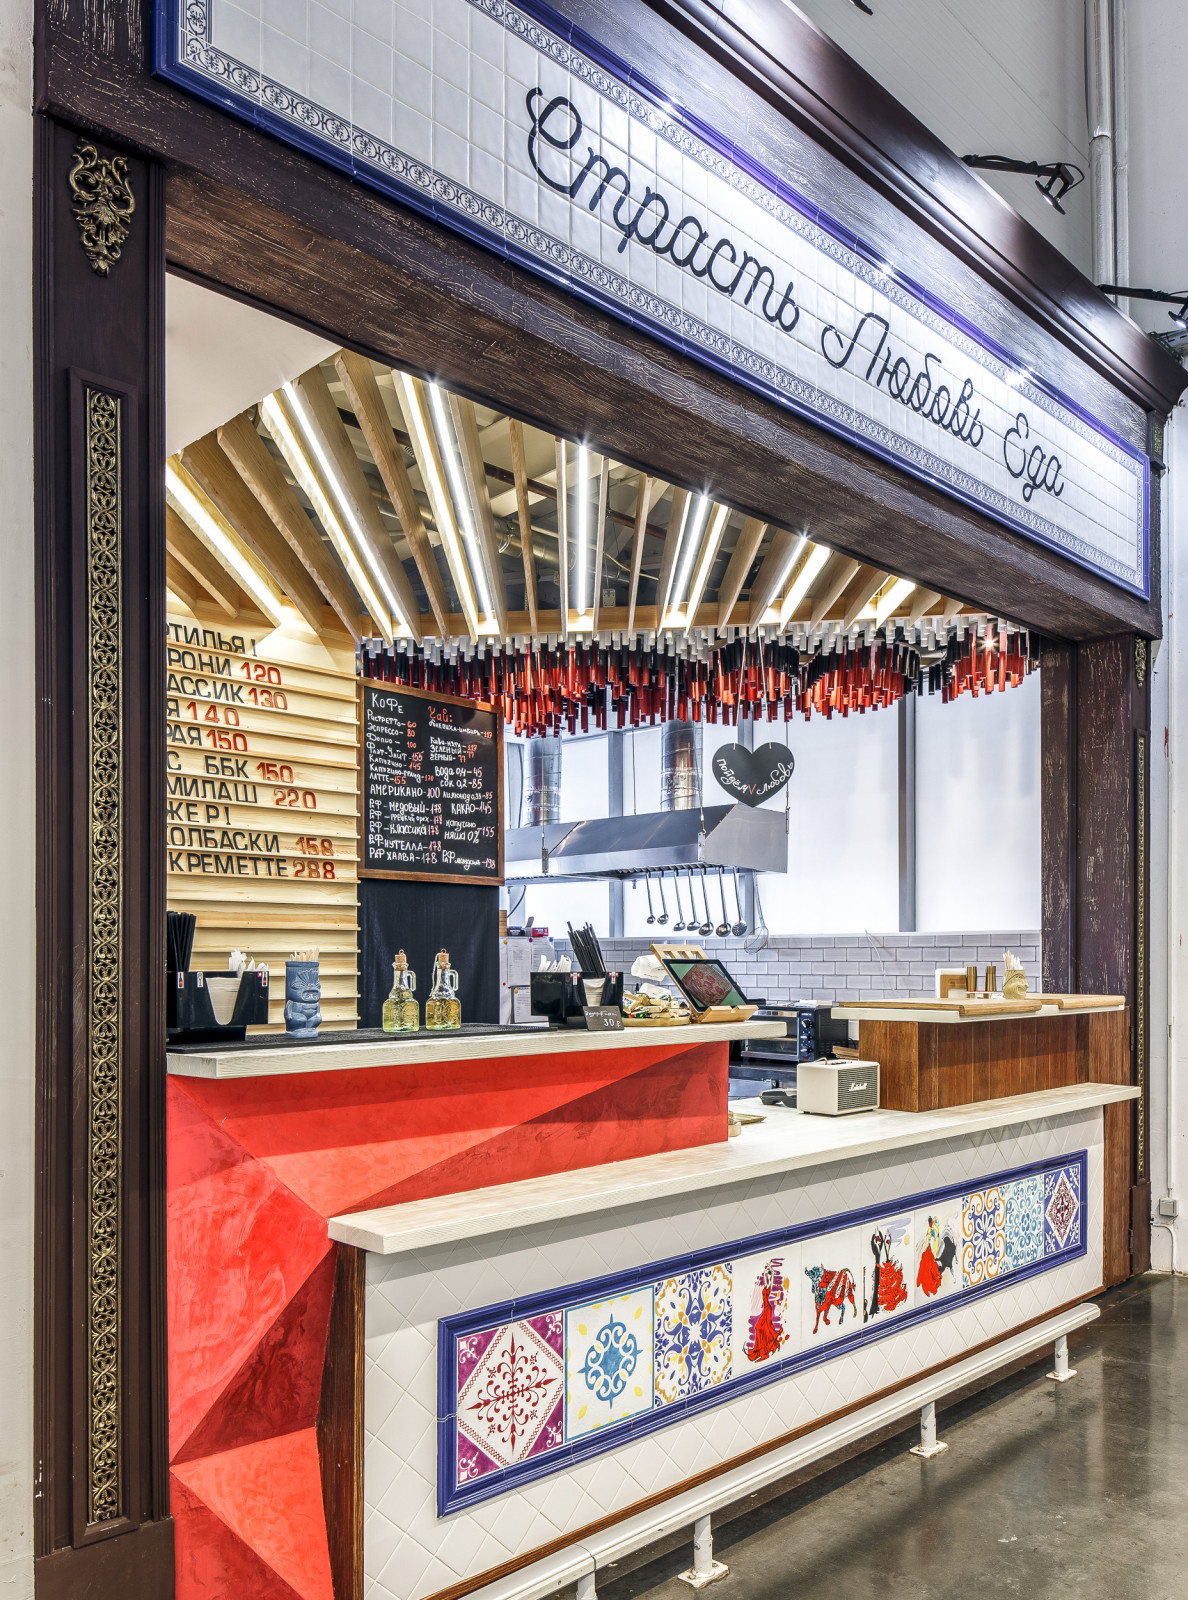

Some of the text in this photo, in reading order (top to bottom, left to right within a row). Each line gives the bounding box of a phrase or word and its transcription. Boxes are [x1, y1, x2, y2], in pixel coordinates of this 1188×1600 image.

[525, 86, 1066, 502] Страсть Любовь Еда
[166, 622, 258, 658] ТИЛЬЯ!
[167, 647, 282, 686] РОНИ 120
[167, 673, 289, 711] АССИК 130
[167, 697, 241, 727] Я 140
[407, 720, 417, 728] 60
[206, 729, 249, 752] 150
[406, 728, 416, 737] 80
[406, 741, 417, 749] 100
[167, 750, 295, 784] С ББК 150
[409, 761, 422, 771] 145
[166, 776, 318, 810] МИЛАШ 220
[166, 825, 335, 857] ОЛБАСКИ 158
[168, 851, 337, 880] КРЕМЕТТЕ 288
